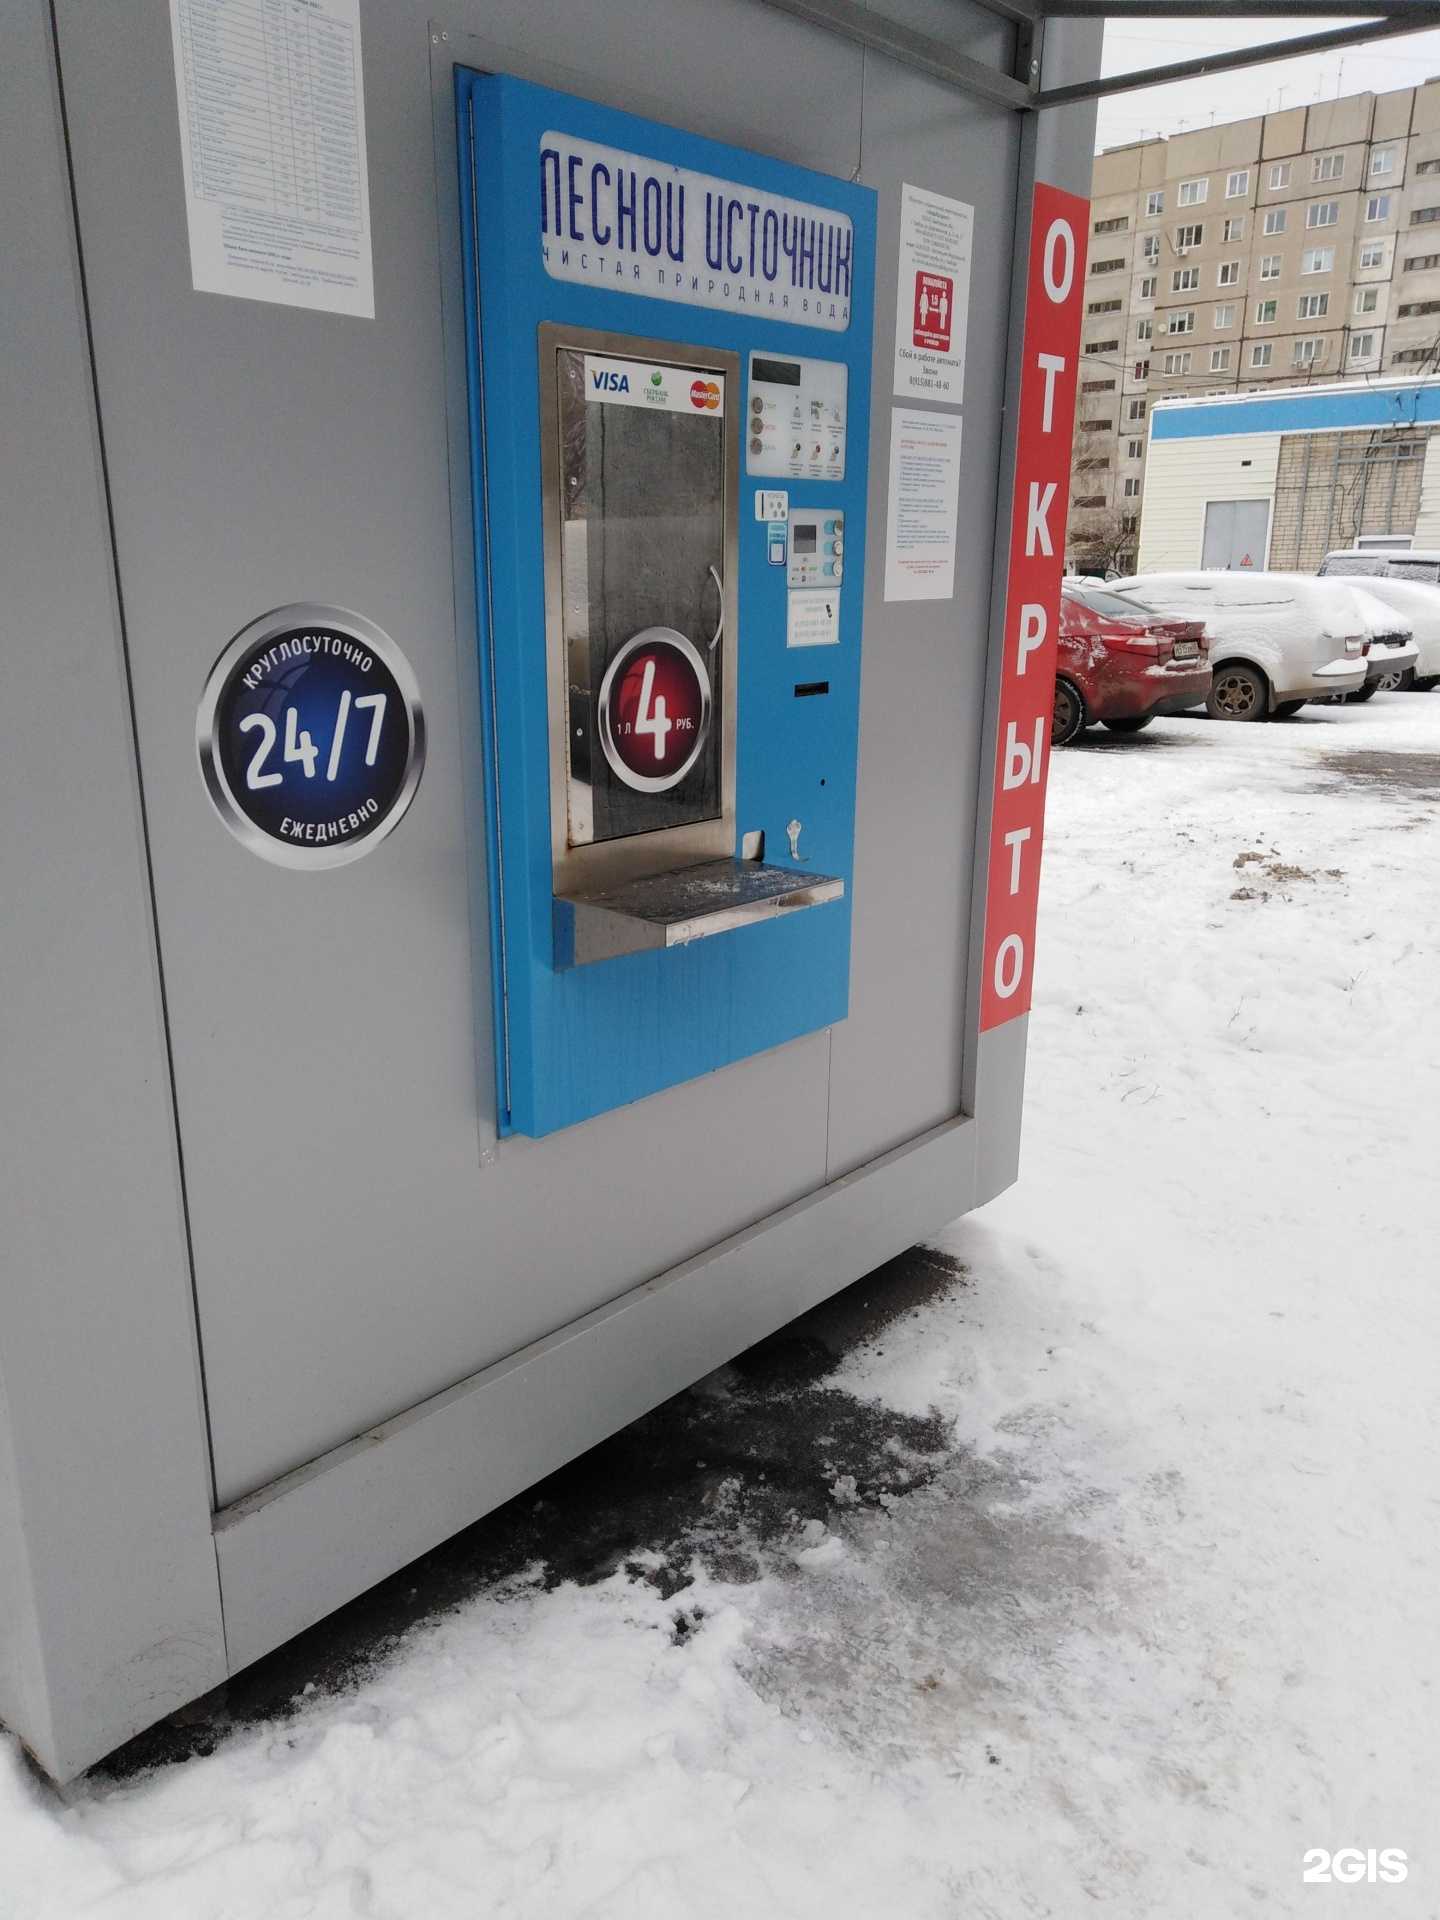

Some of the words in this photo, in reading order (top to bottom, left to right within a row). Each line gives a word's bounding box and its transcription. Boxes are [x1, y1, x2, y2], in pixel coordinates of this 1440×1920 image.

[706, 192, 851, 298] ИСТОЧНИК
[543, 247, 640, 280] ЧИСТАЯ
[658, 269, 789, 308] ПРИРОДНАЯ
[803, 298, 849, 321] ВОДА
[591, 369, 630, 393] VISA
[918, 351, 936, 364] работе
[993, 217, 1076, 999] ОТКРЫТО
[242, 635, 374, 691] КРУГЛОСУТОЧНО
[239, 690, 388, 791] 24/7
[617, 723, 622, 735] 1
[634, 660, 672, 760] 4
[676, 717, 695, 731] РУБ.
[279, 798, 379, 842] ЕЖЕДНЕВНО
